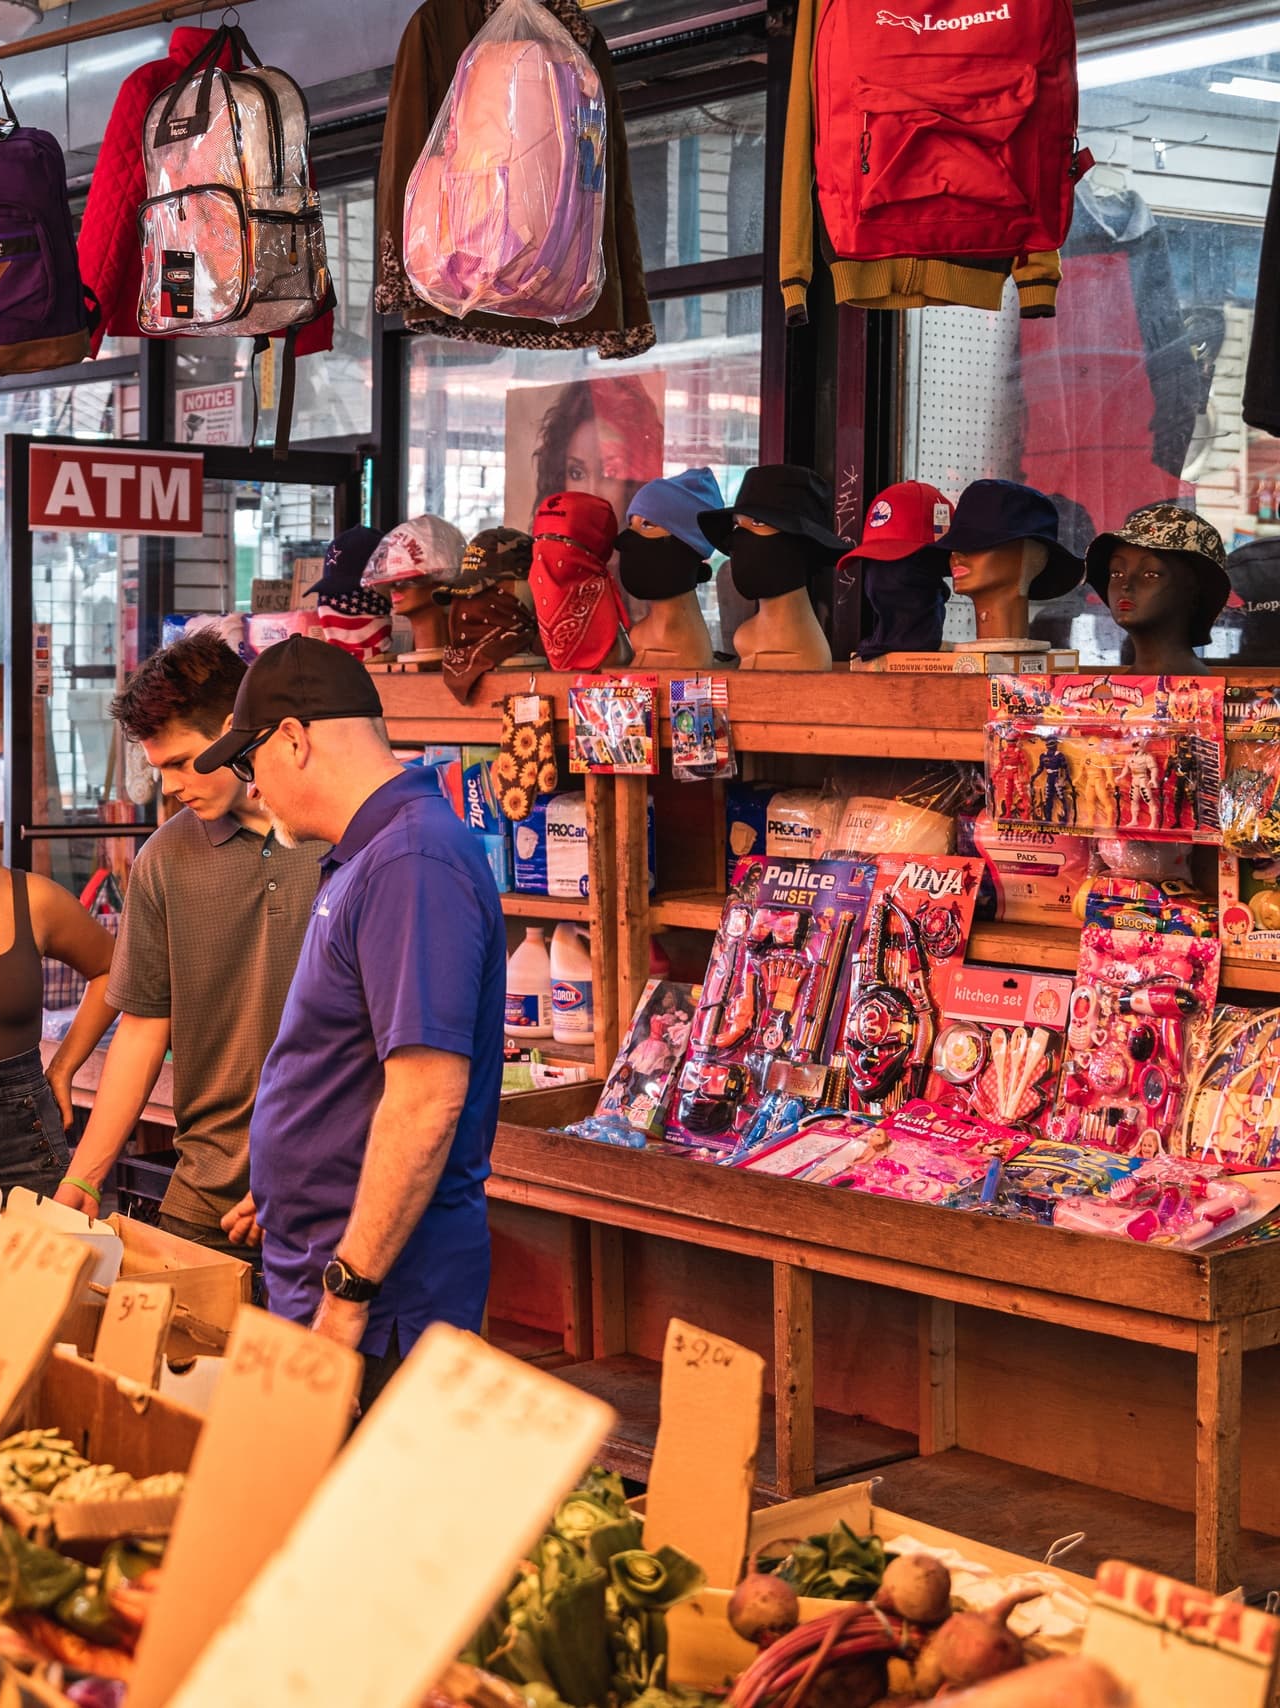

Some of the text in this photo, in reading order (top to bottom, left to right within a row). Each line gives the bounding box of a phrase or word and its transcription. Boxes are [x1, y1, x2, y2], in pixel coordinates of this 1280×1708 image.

[923, 4, 1011, 31] Leopard
[185, 390, 233, 410] NOTICE
[44, 461, 190, 521] ATM
[467, 779, 486, 829] Ziploc
[768, 820, 822, 839] PROCare
[1017, 853, 1037, 862] PADS
[763, 864, 835, 890] Police
[891, 862, 963, 899] NINJA
[787, 889, 818, 905] SET
[1058, 895, 1072, 904] 42
[1115, 915, 1155, 932] BLOCKS
[954, 986, 1022, 1007] kitchen set
[893, 1112, 932, 1130] Pretty
